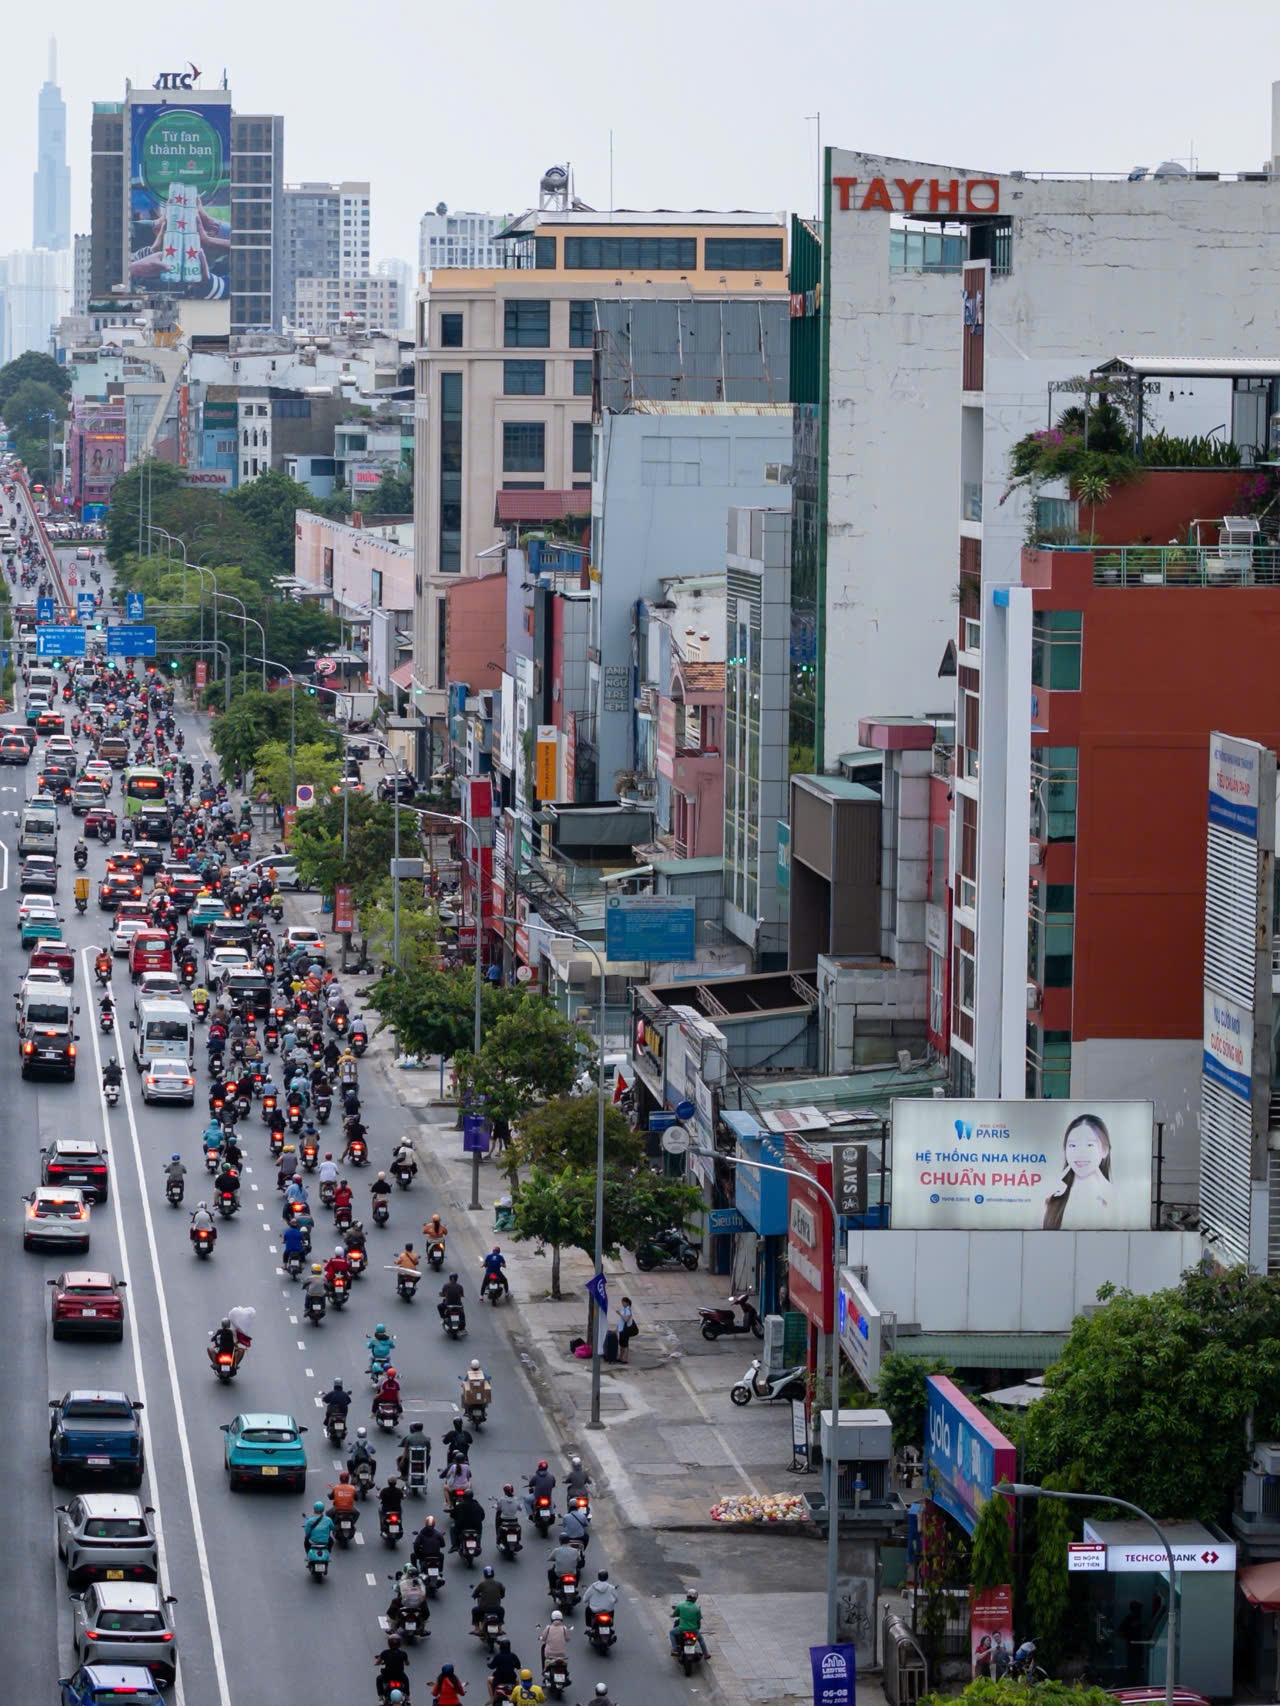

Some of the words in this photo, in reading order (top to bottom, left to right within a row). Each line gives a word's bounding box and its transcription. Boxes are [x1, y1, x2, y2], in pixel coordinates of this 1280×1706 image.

[181, 131, 200, 142] fan
[150, 144, 186, 155] thành
[189, 144, 212, 157] bạn
[833, 177, 999, 212] TAYHO
[976, 1129, 1010, 1139] PARIS
[915, 1150, 932, 1164] HỆ
[935, 1147, 978, 1163] THỐNG
[981, 1153, 1008, 1163] NHA
[1012, 1153, 1047, 1163] KHOA
[843, 1164, 858, 1193] SAY
[920, 1167, 986, 1186] CHUẨN
[991, 1169, 1042, 1186] PHÁP
[930, 1403, 950, 1459] yola
[823, 1689, 848, 1698] 06-08
